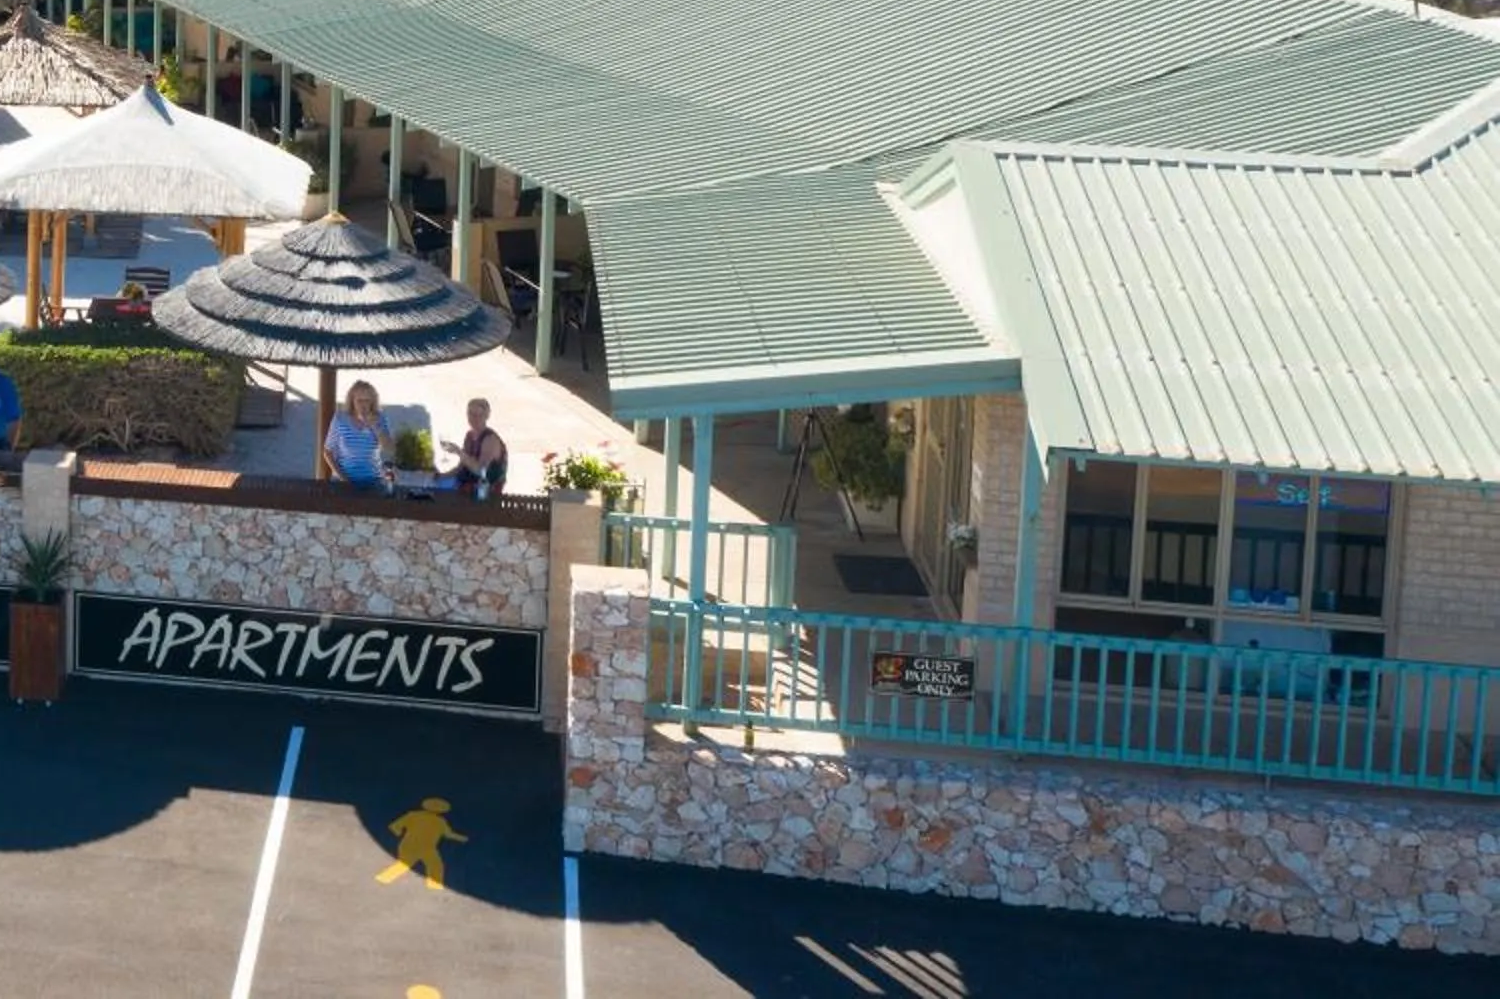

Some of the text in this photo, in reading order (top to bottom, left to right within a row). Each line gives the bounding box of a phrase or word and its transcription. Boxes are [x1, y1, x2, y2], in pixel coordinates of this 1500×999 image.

[118, 607, 495, 693] APARTMENTS
[913, 658, 961, 673] GUEST
[904, 669, 969, 686] PARKING
[917, 682, 955, 697] ONLY
